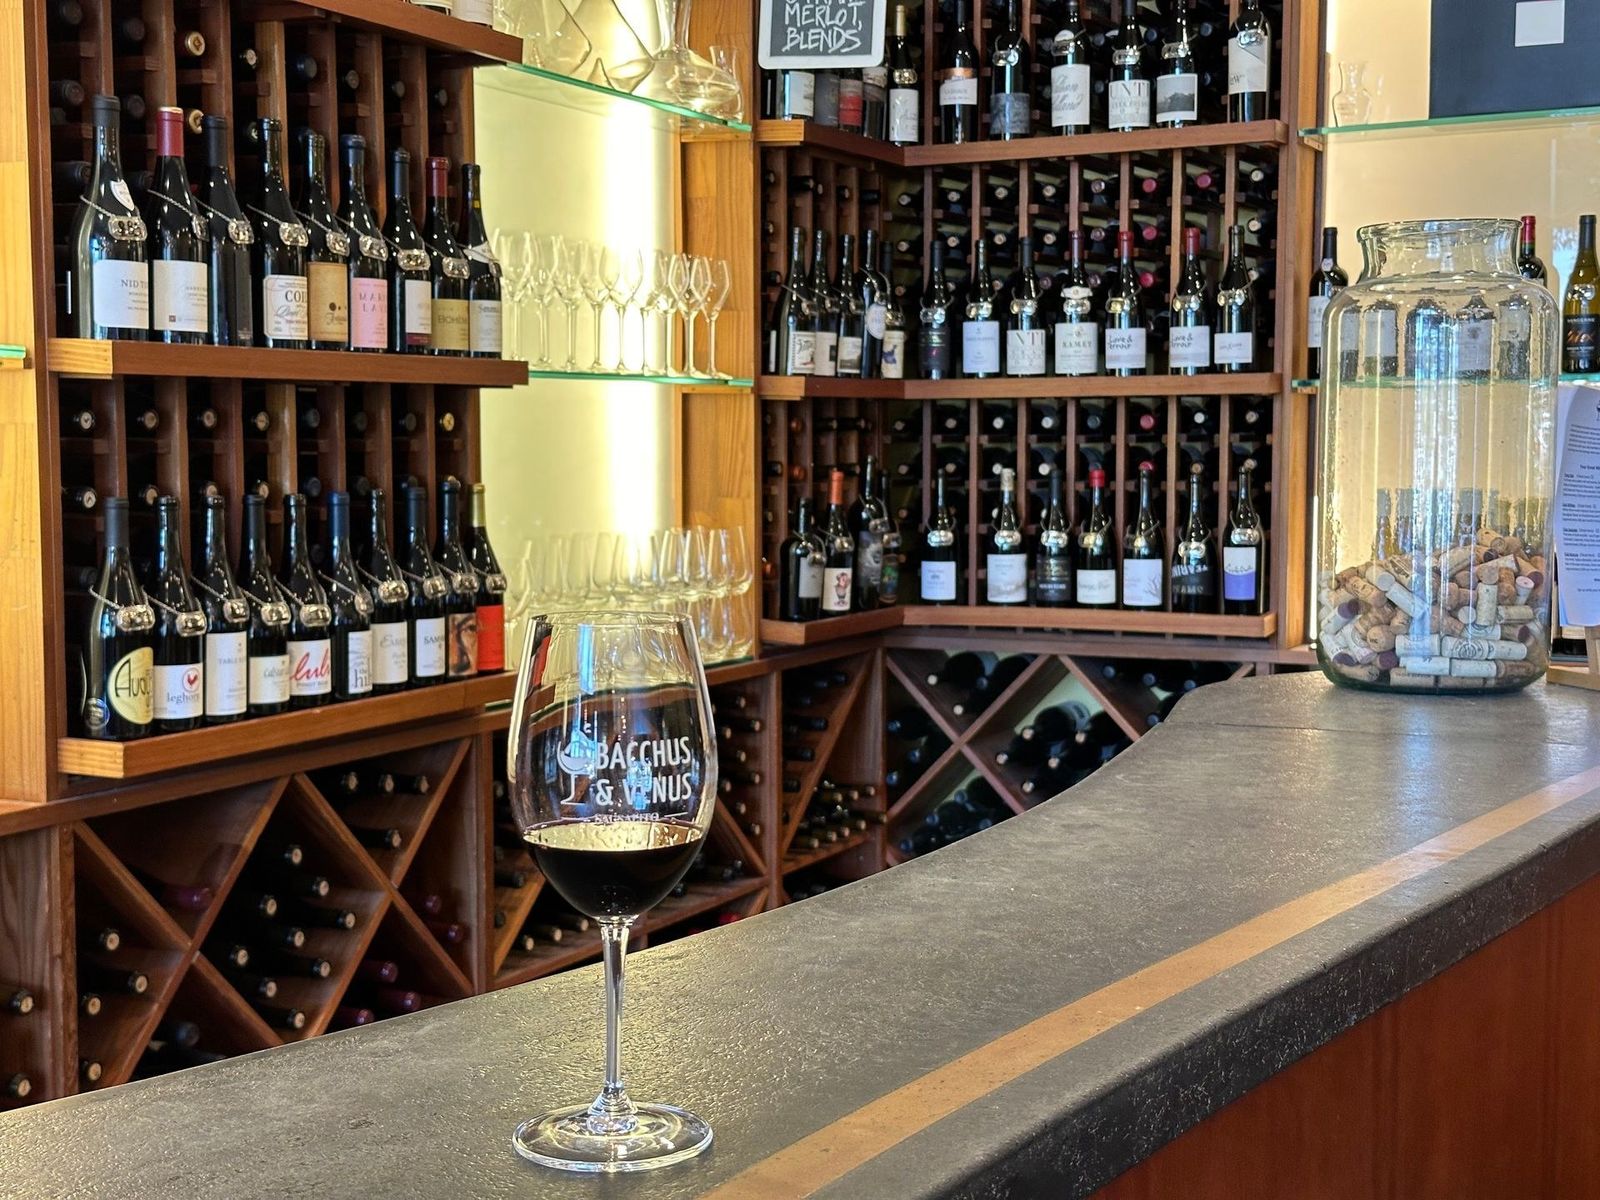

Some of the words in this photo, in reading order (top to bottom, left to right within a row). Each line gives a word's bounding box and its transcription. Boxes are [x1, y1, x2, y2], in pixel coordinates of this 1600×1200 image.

[785, 1, 866, 31] MERLOT,
[781, 27, 862, 53] BLENDS
[598, 736, 692, 770] BACCHUS
[596, 779, 614, 806] &
[623, 773, 692, 806] VENUS
